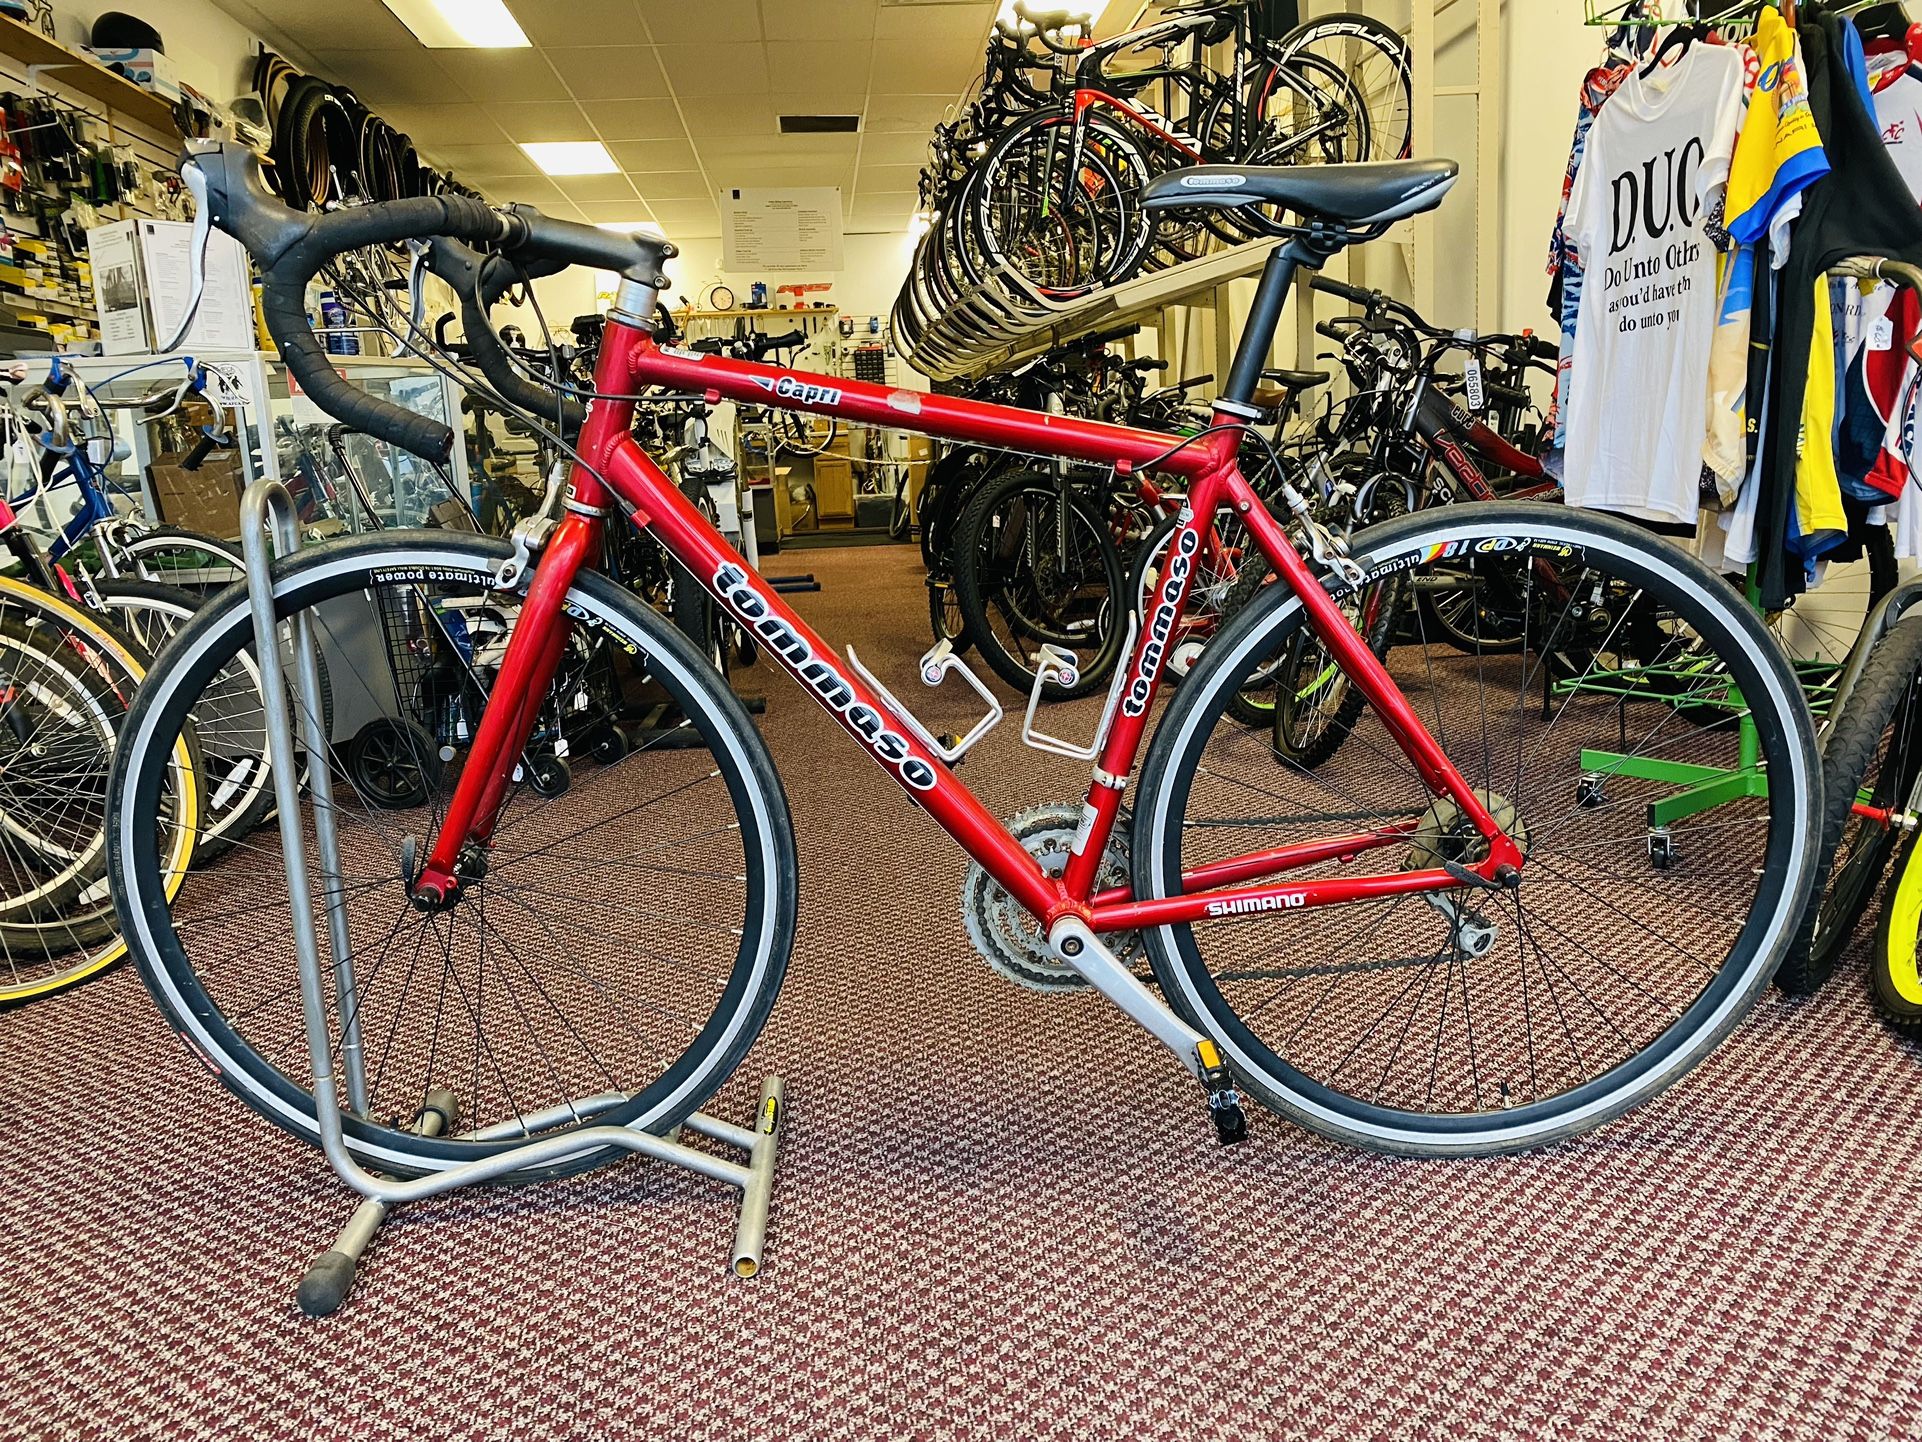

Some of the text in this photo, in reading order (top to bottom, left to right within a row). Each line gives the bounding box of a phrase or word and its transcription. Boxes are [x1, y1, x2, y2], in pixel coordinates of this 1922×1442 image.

[1116, 97, 1203, 156] SAVA
[1604, 267, 1621, 292] Do
[1623, 255, 1660, 283] Unto
[1619, 315, 1637, 333] do
[1640, 311, 1664, 330] unto
[775, 375, 843, 406] Capri
[1466, 369, 1482, 408] 065803
[1443, 541, 1469, 558] 18
[375, 568, 497, 587] ultimate power
[1122, 527, 1200, 718] tommaso
[712, 561, 938, 791] tommaso
[1208, 893, 1305, 917] SHIMANO
